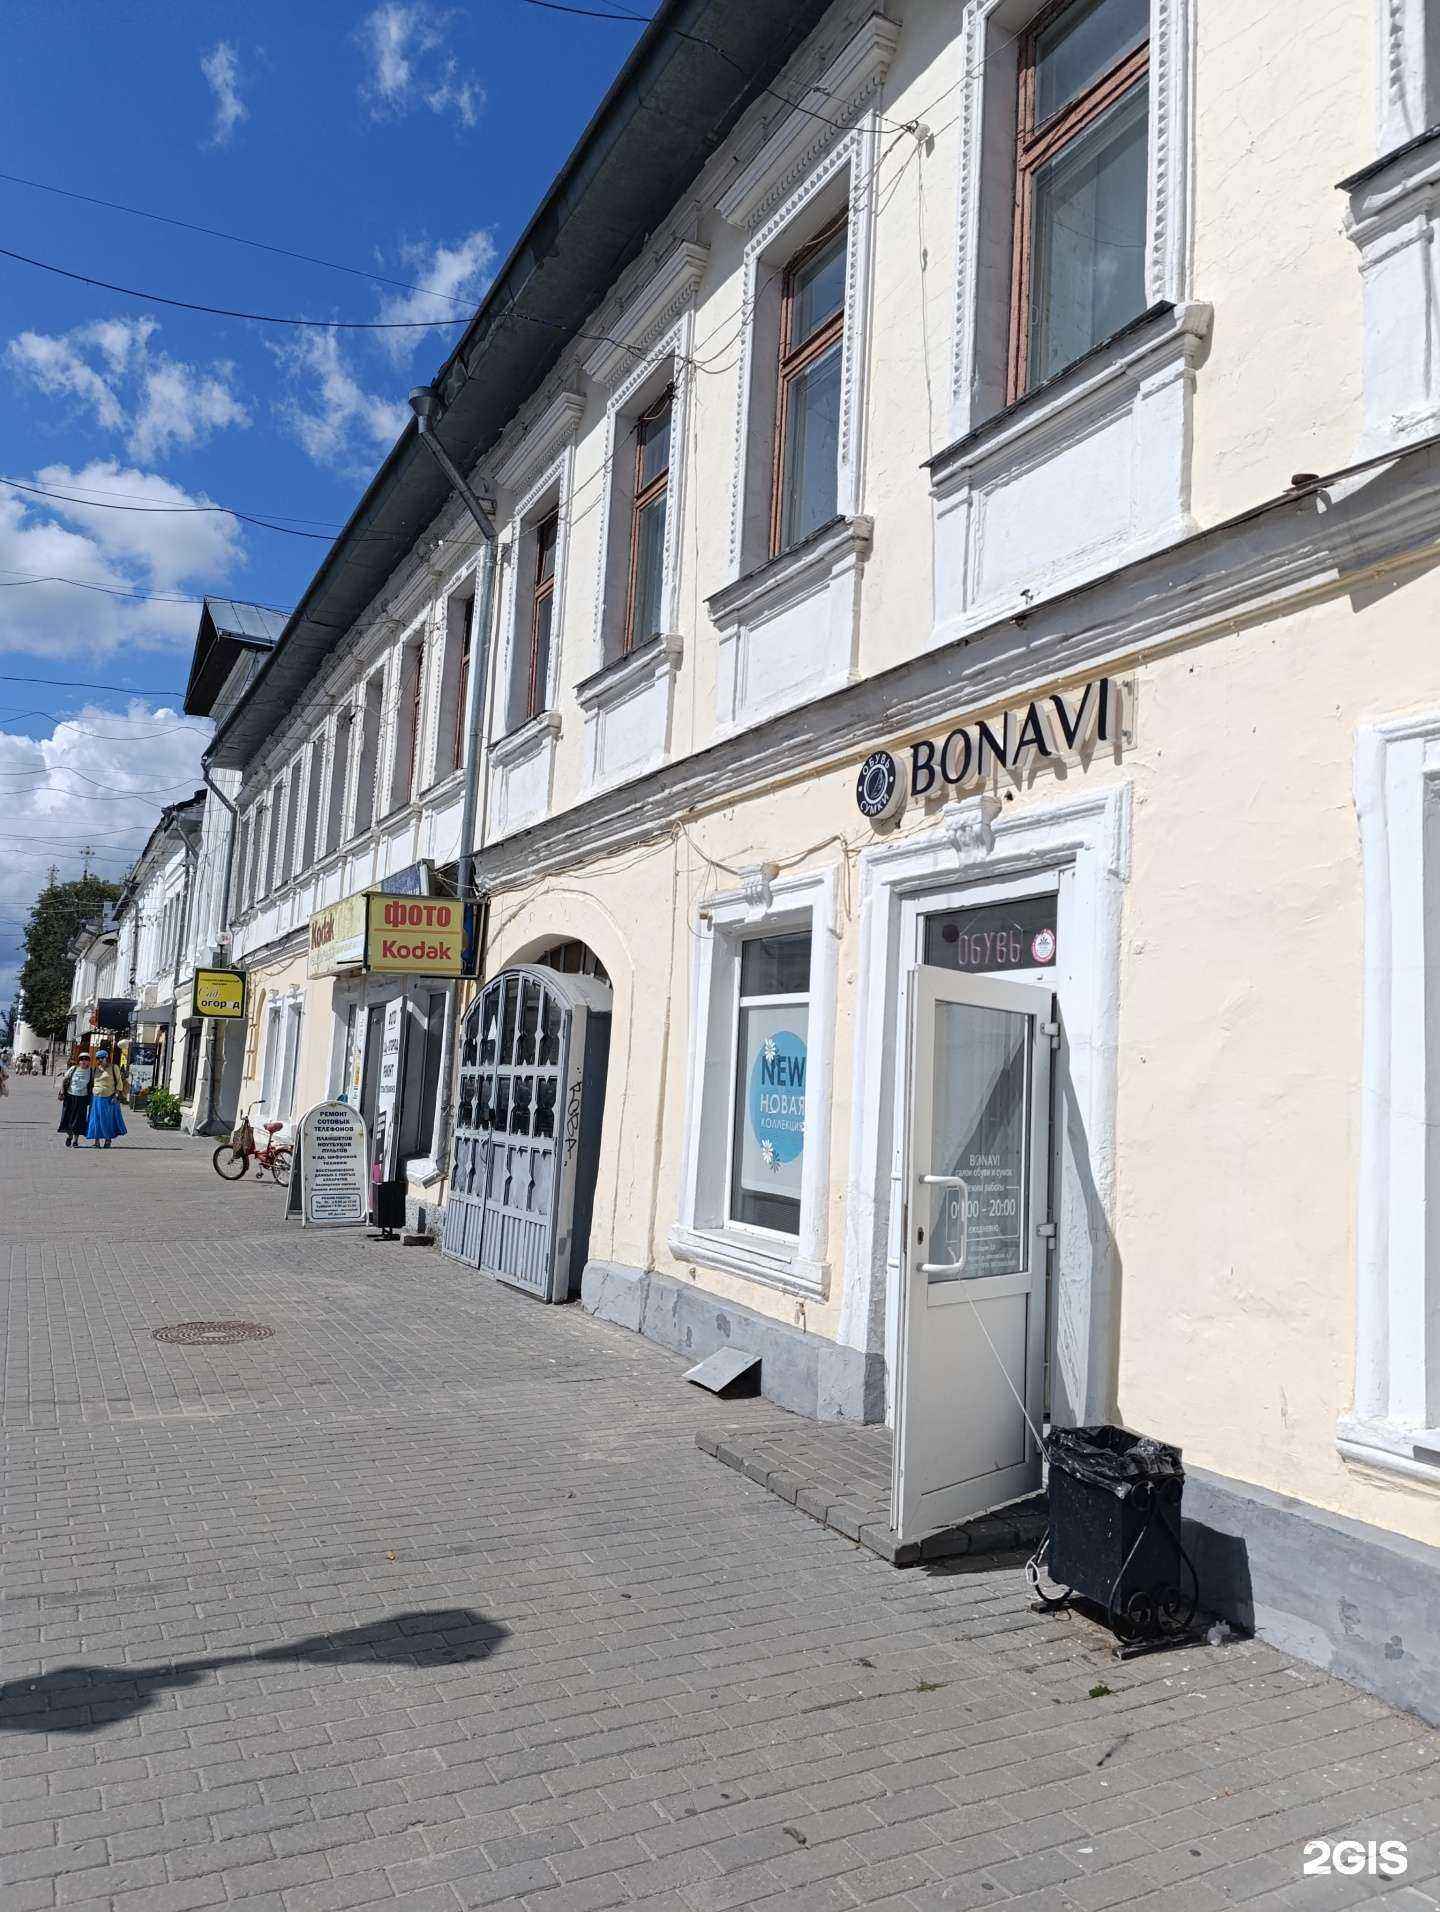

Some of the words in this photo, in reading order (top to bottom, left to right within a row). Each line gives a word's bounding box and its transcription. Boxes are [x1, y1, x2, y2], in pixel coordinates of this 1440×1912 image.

[910, 678, 1108, 797] BONAVI
[863, 754, 890, 775] ОБУВЬ
[860, 793, 889, 815] СУМКИ
[310, 912, 335, 950] Kodak
[383, 940, 451, 960] Kodak
[761, 1055, 806, 1087] NEW
[969, 1153, 1000, 1167] BONAVI
[989, 1199, 1016, 1216] 20:00
